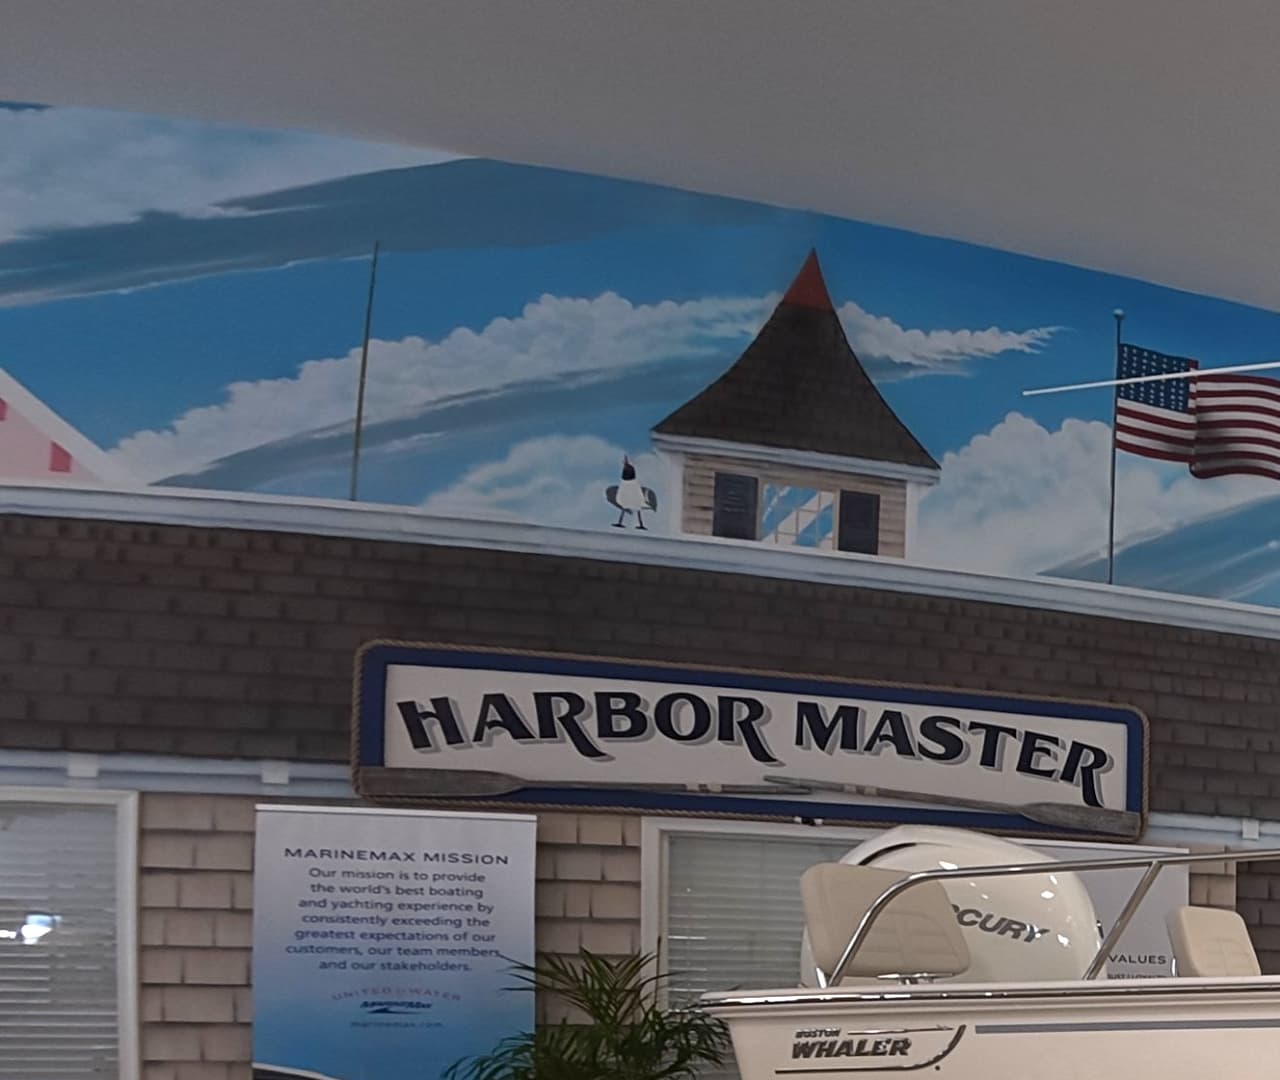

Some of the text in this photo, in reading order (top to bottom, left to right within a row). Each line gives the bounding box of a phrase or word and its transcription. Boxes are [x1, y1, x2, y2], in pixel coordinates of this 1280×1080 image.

[396, 690, 1116, 808] HARBOR MASTER
[284, 847, 509, 865] MARINEMAX MISSION
[308, 867, 486, 883] Our mission is to provide
[310, 883, 484, 900] the world's best boating
[298, 898, 495, 915] and yachting experience by
[301, 915, 491, 929] consistently exceeding the
[951, 903, 1051, 943] CURY
[294, 930, 497, 944] greatest expectations of our
[285, 945, 364, 956] customers,
[367, 947, 393, 956] our
[397, 948, 433, 957] team
[318, 961, 472, 972] and our stakeholders.
[1107, 955, 1167, 965] VALUES
[792, 1038, 912, 1059] WHALER
